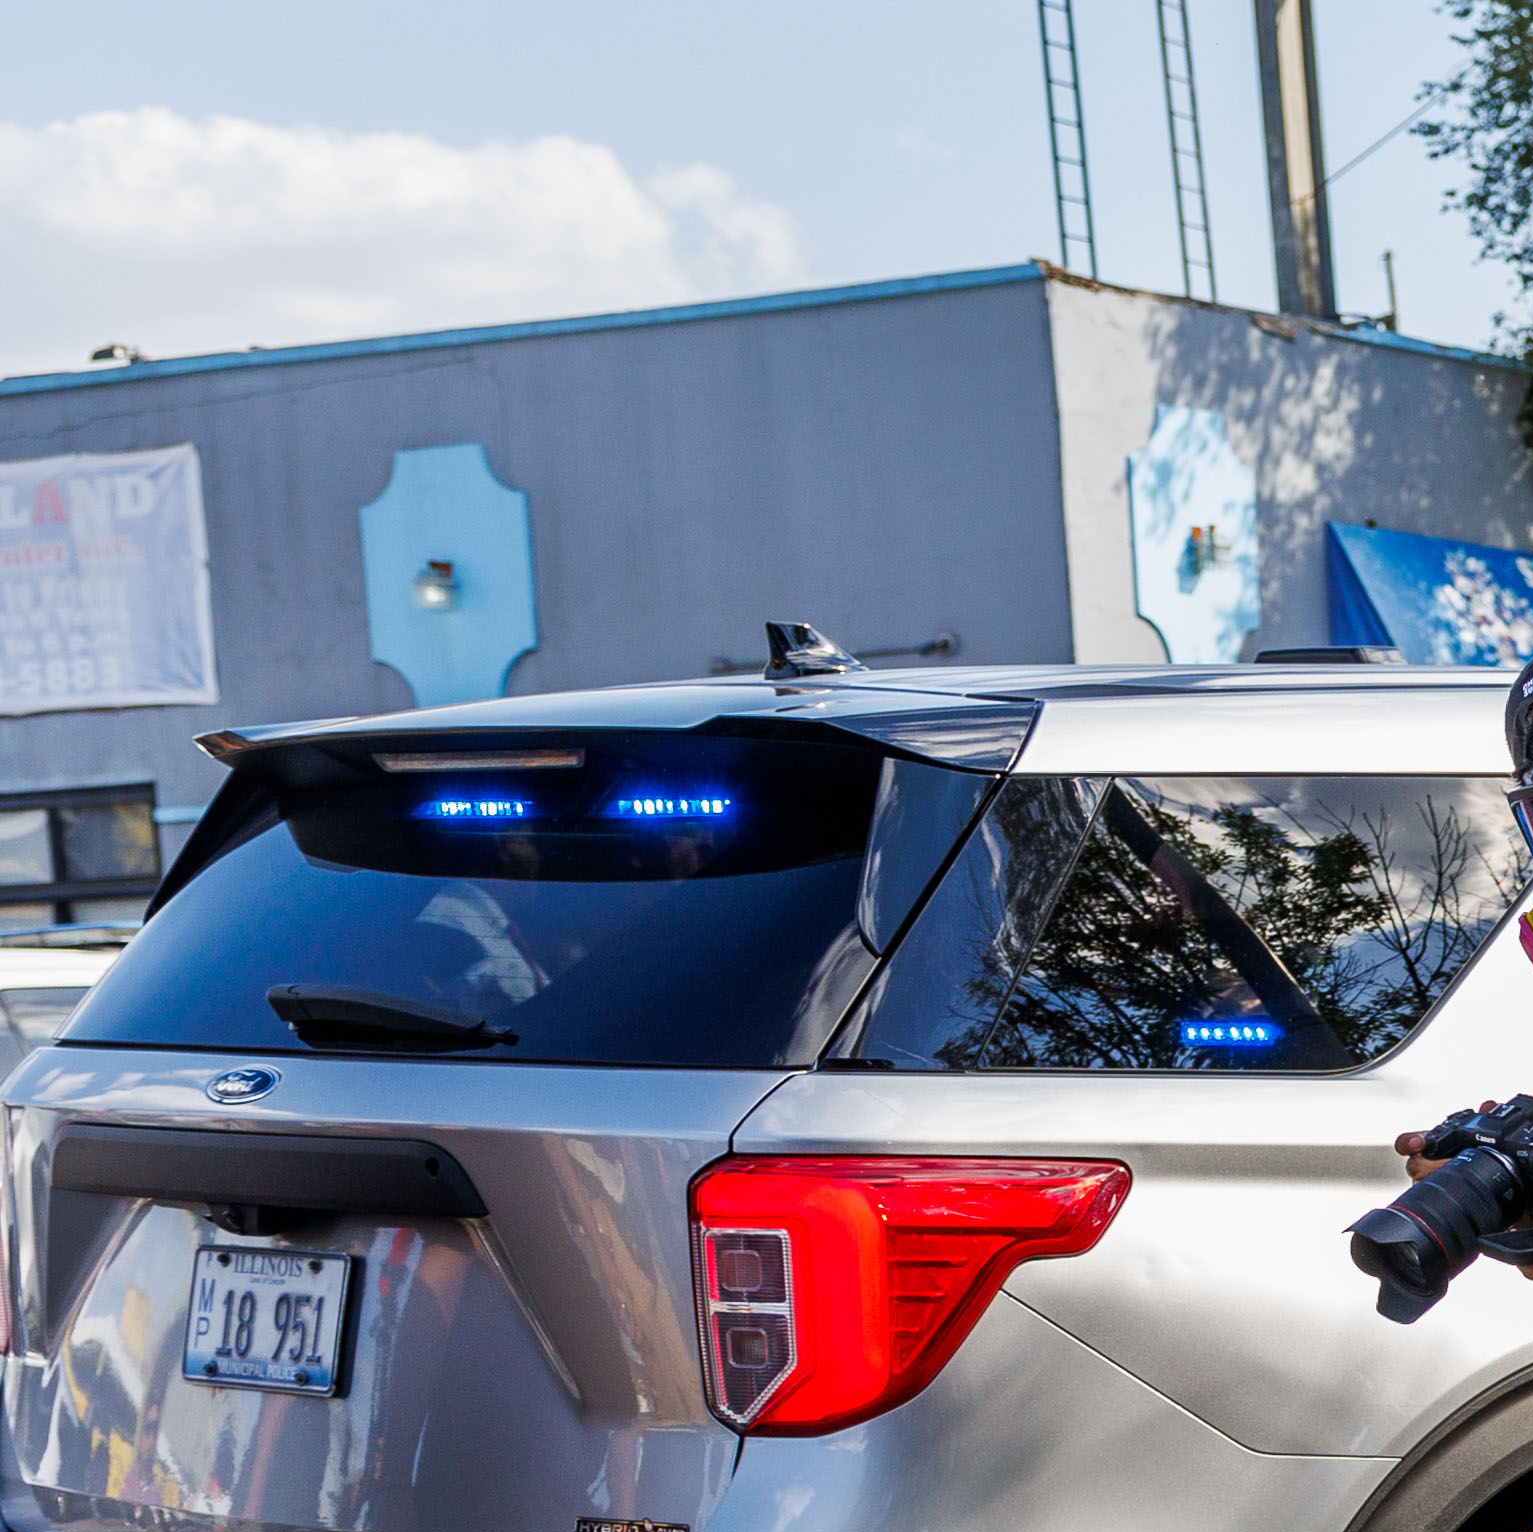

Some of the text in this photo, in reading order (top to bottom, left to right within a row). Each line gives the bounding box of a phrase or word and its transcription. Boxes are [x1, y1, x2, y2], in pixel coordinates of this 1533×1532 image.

[214, 1070, 263, 1092] Ford
[234, 1254, 303, 1278] ILLINOIS
[215, 1289, 325, 1364] 18 951
[218, 1360, 298, 1381] MUNICIPAL POLICE
